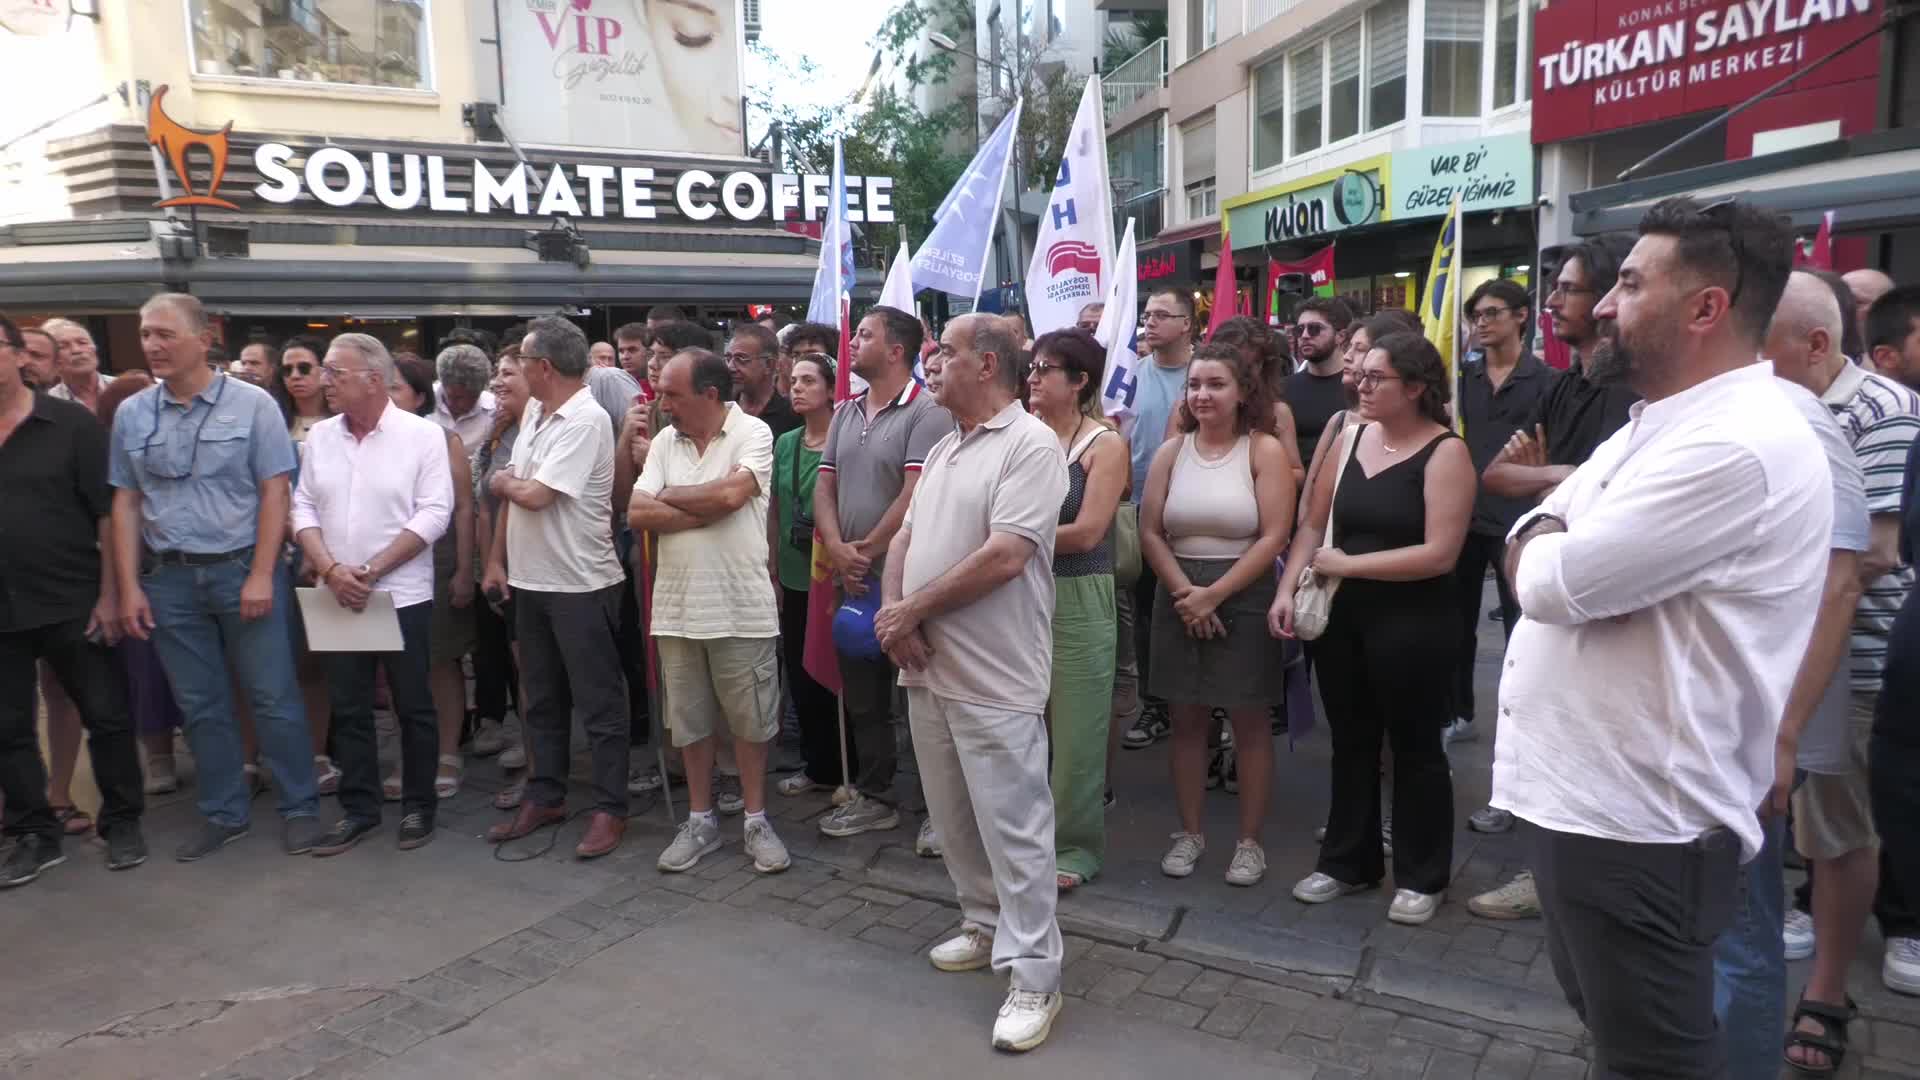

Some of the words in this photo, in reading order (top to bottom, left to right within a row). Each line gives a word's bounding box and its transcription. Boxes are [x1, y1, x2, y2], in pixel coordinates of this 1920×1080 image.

[1618, 2, 1673, 28] KONAK
[1538, 20, 1685, 90] TÜRKAN
[1594, 69, 1681, 105] KÜLTÜR
[1688, 36, 1806, 85] MERKEZİ
[253, 142, 657, 219] SOULMATE
[675, 169, 894, 222] COFFEE
[1430, 154, 1460, 177] VAR
